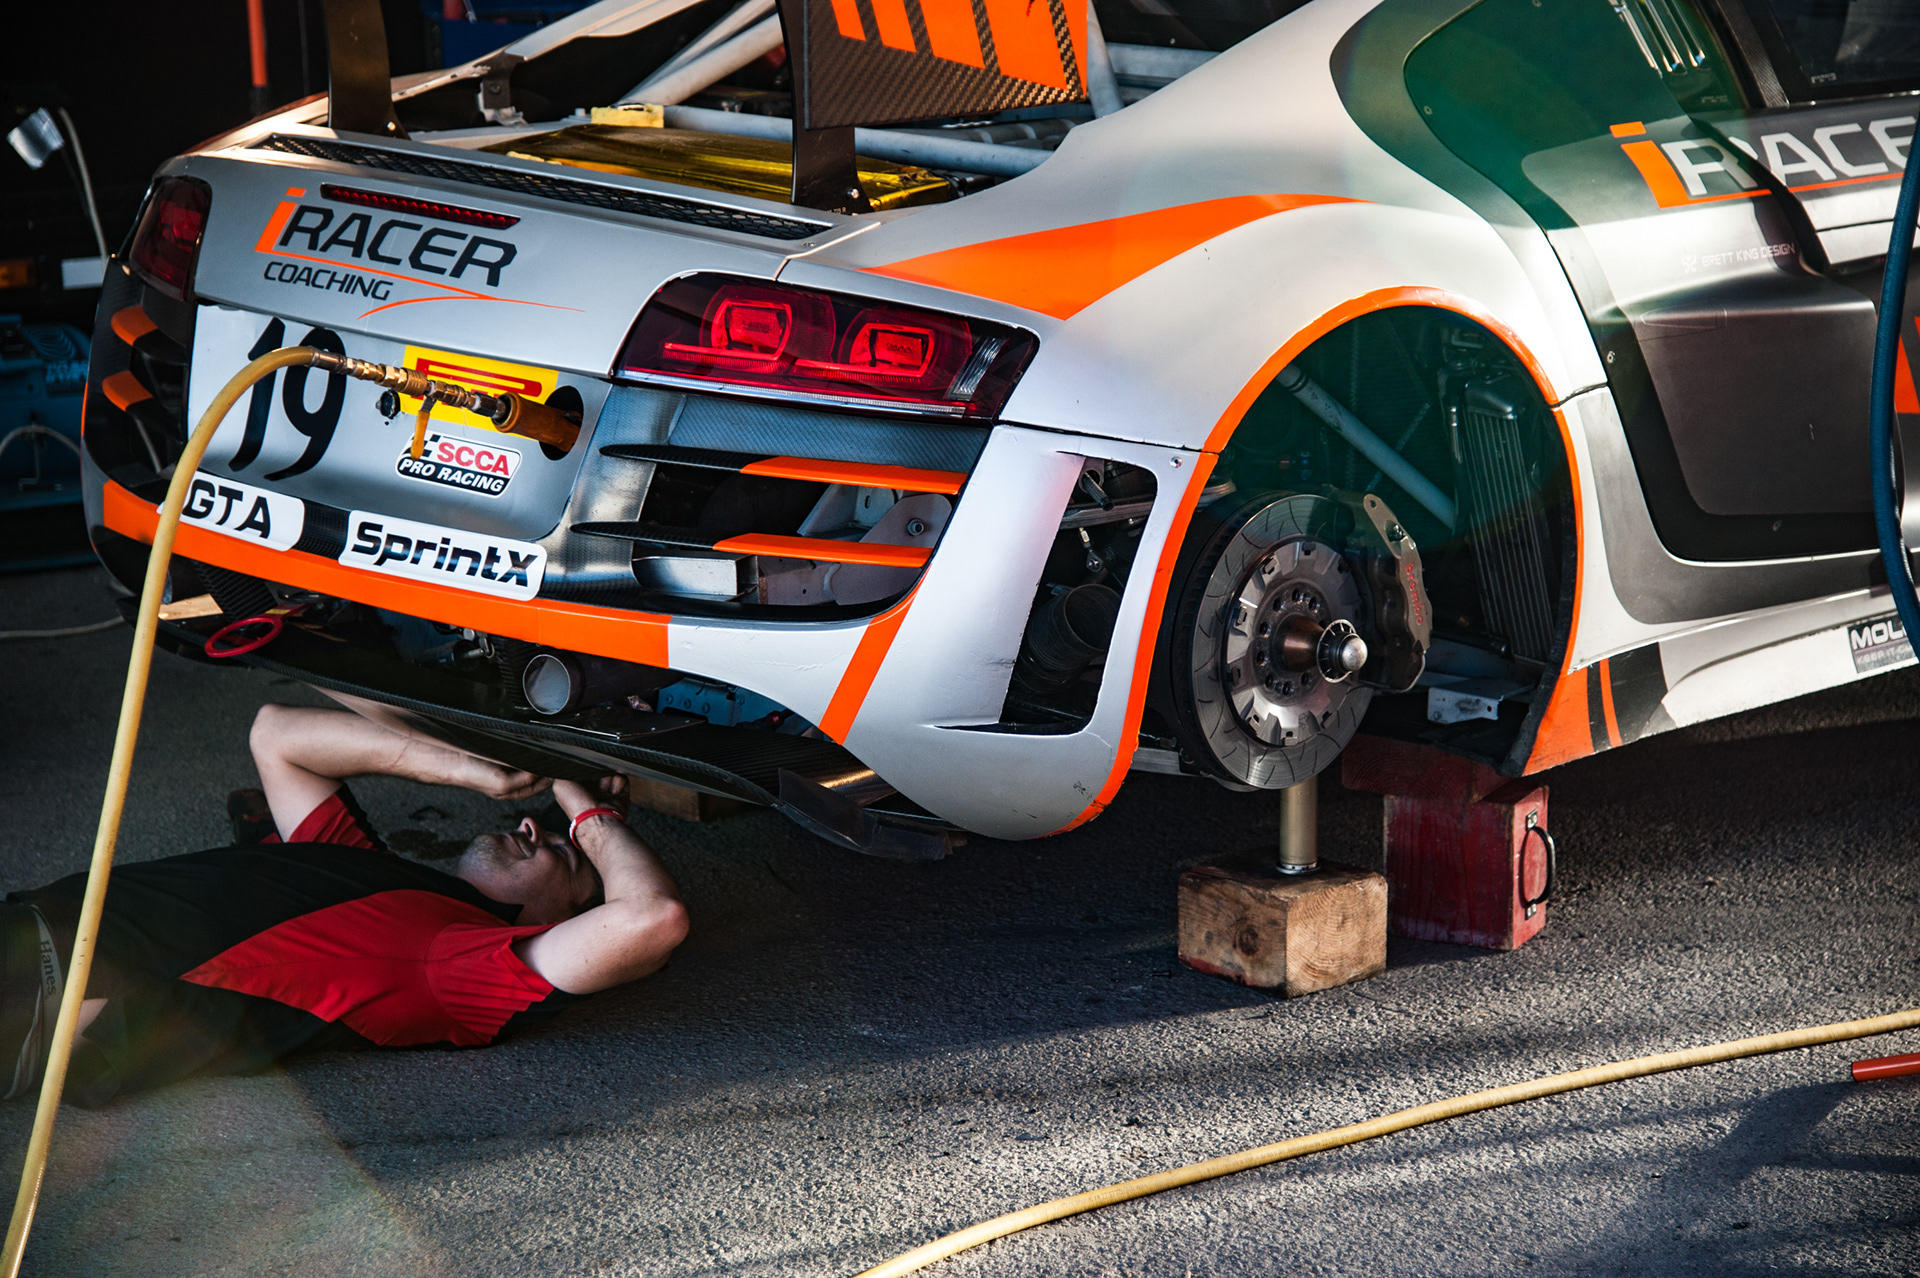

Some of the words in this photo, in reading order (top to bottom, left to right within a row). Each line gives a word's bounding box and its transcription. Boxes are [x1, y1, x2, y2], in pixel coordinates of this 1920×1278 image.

[255, 188, 517, 287] iRACER
[1701, 252, 1734, 267] BRETT
[1736, 248, 1759, 262] KING
[1761, 243, 1796, 259] DESIGN
[264, 261, 393, 301] COACHING
[228, 317, 347, 482] 19
[399, 458, 435, 478] PRO
[437, 467, 505, 494] RACING
[437, 442, 510, 477] SCCA
[182, 479, 272, 540] GTA
[351, 521, 538, 588] SprintX
[1405, 562, 1423, 625] brembo
[1850, 620, 1907, 650] MOL
[40, 940, 57, 996] Hanes
